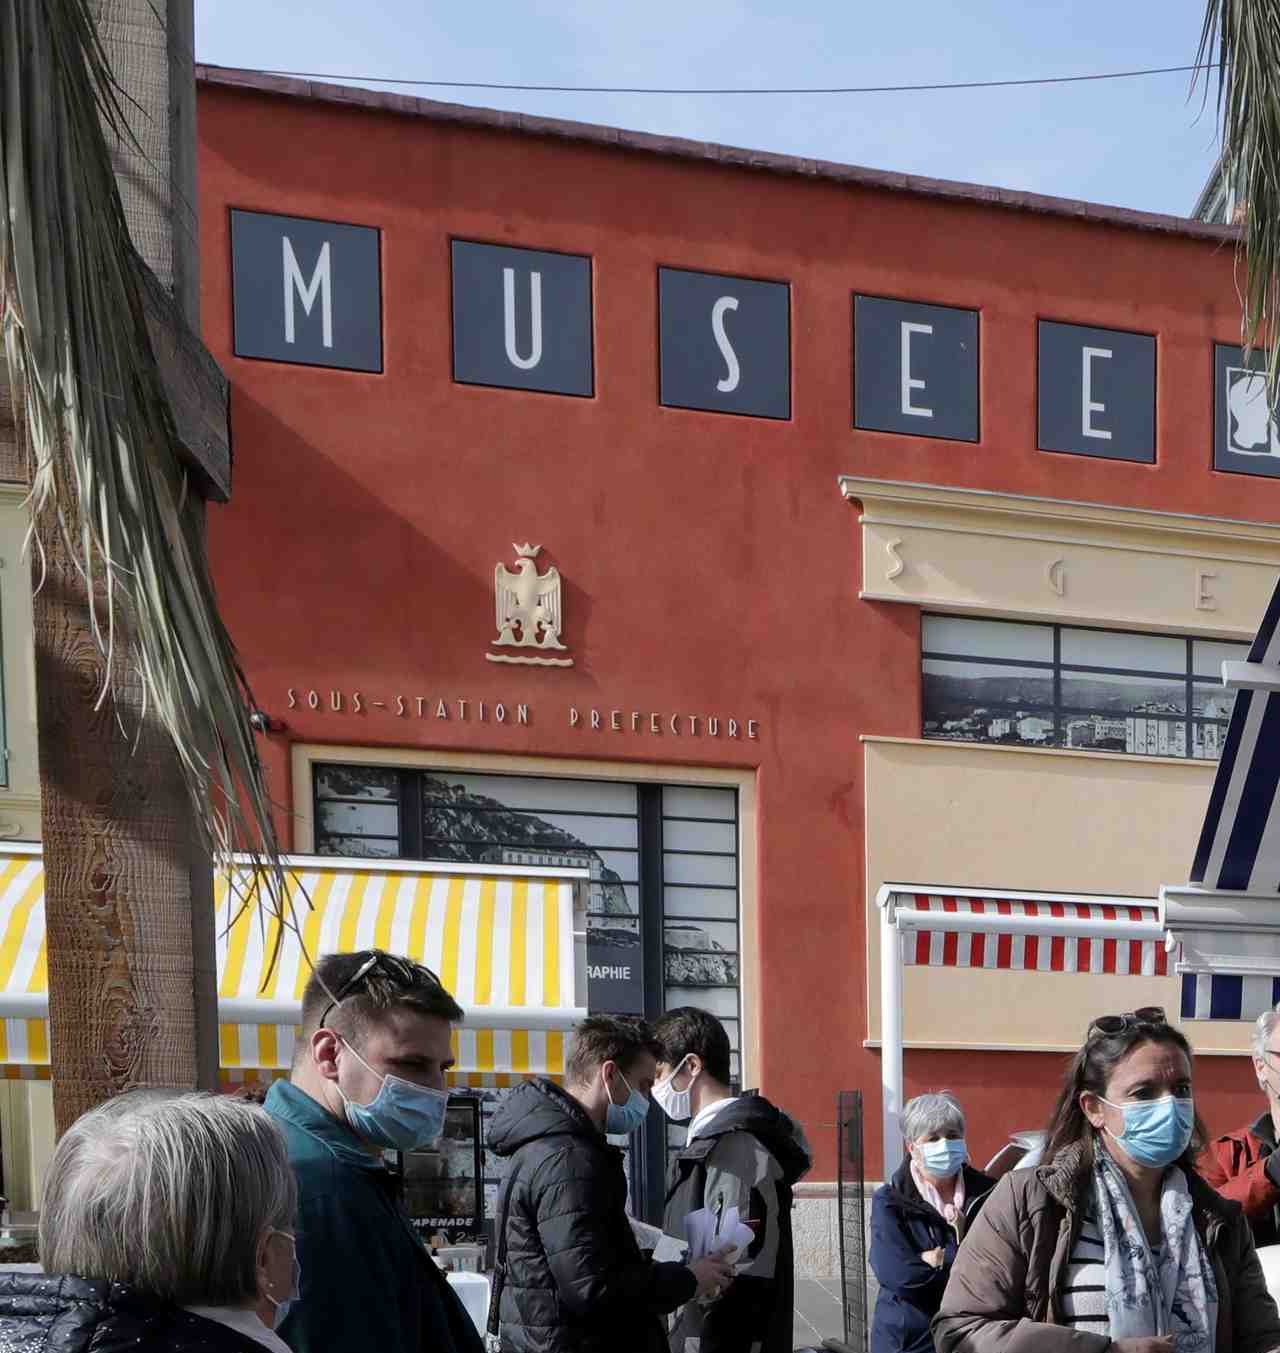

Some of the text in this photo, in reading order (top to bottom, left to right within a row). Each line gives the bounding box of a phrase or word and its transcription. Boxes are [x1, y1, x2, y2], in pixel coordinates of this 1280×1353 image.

[283, 235, 1113, 440] MUSEE
[287, 688, 759, 739] SOUS-STATION PREFECTURE
[409, 1217, 474, 1228] APENADE
